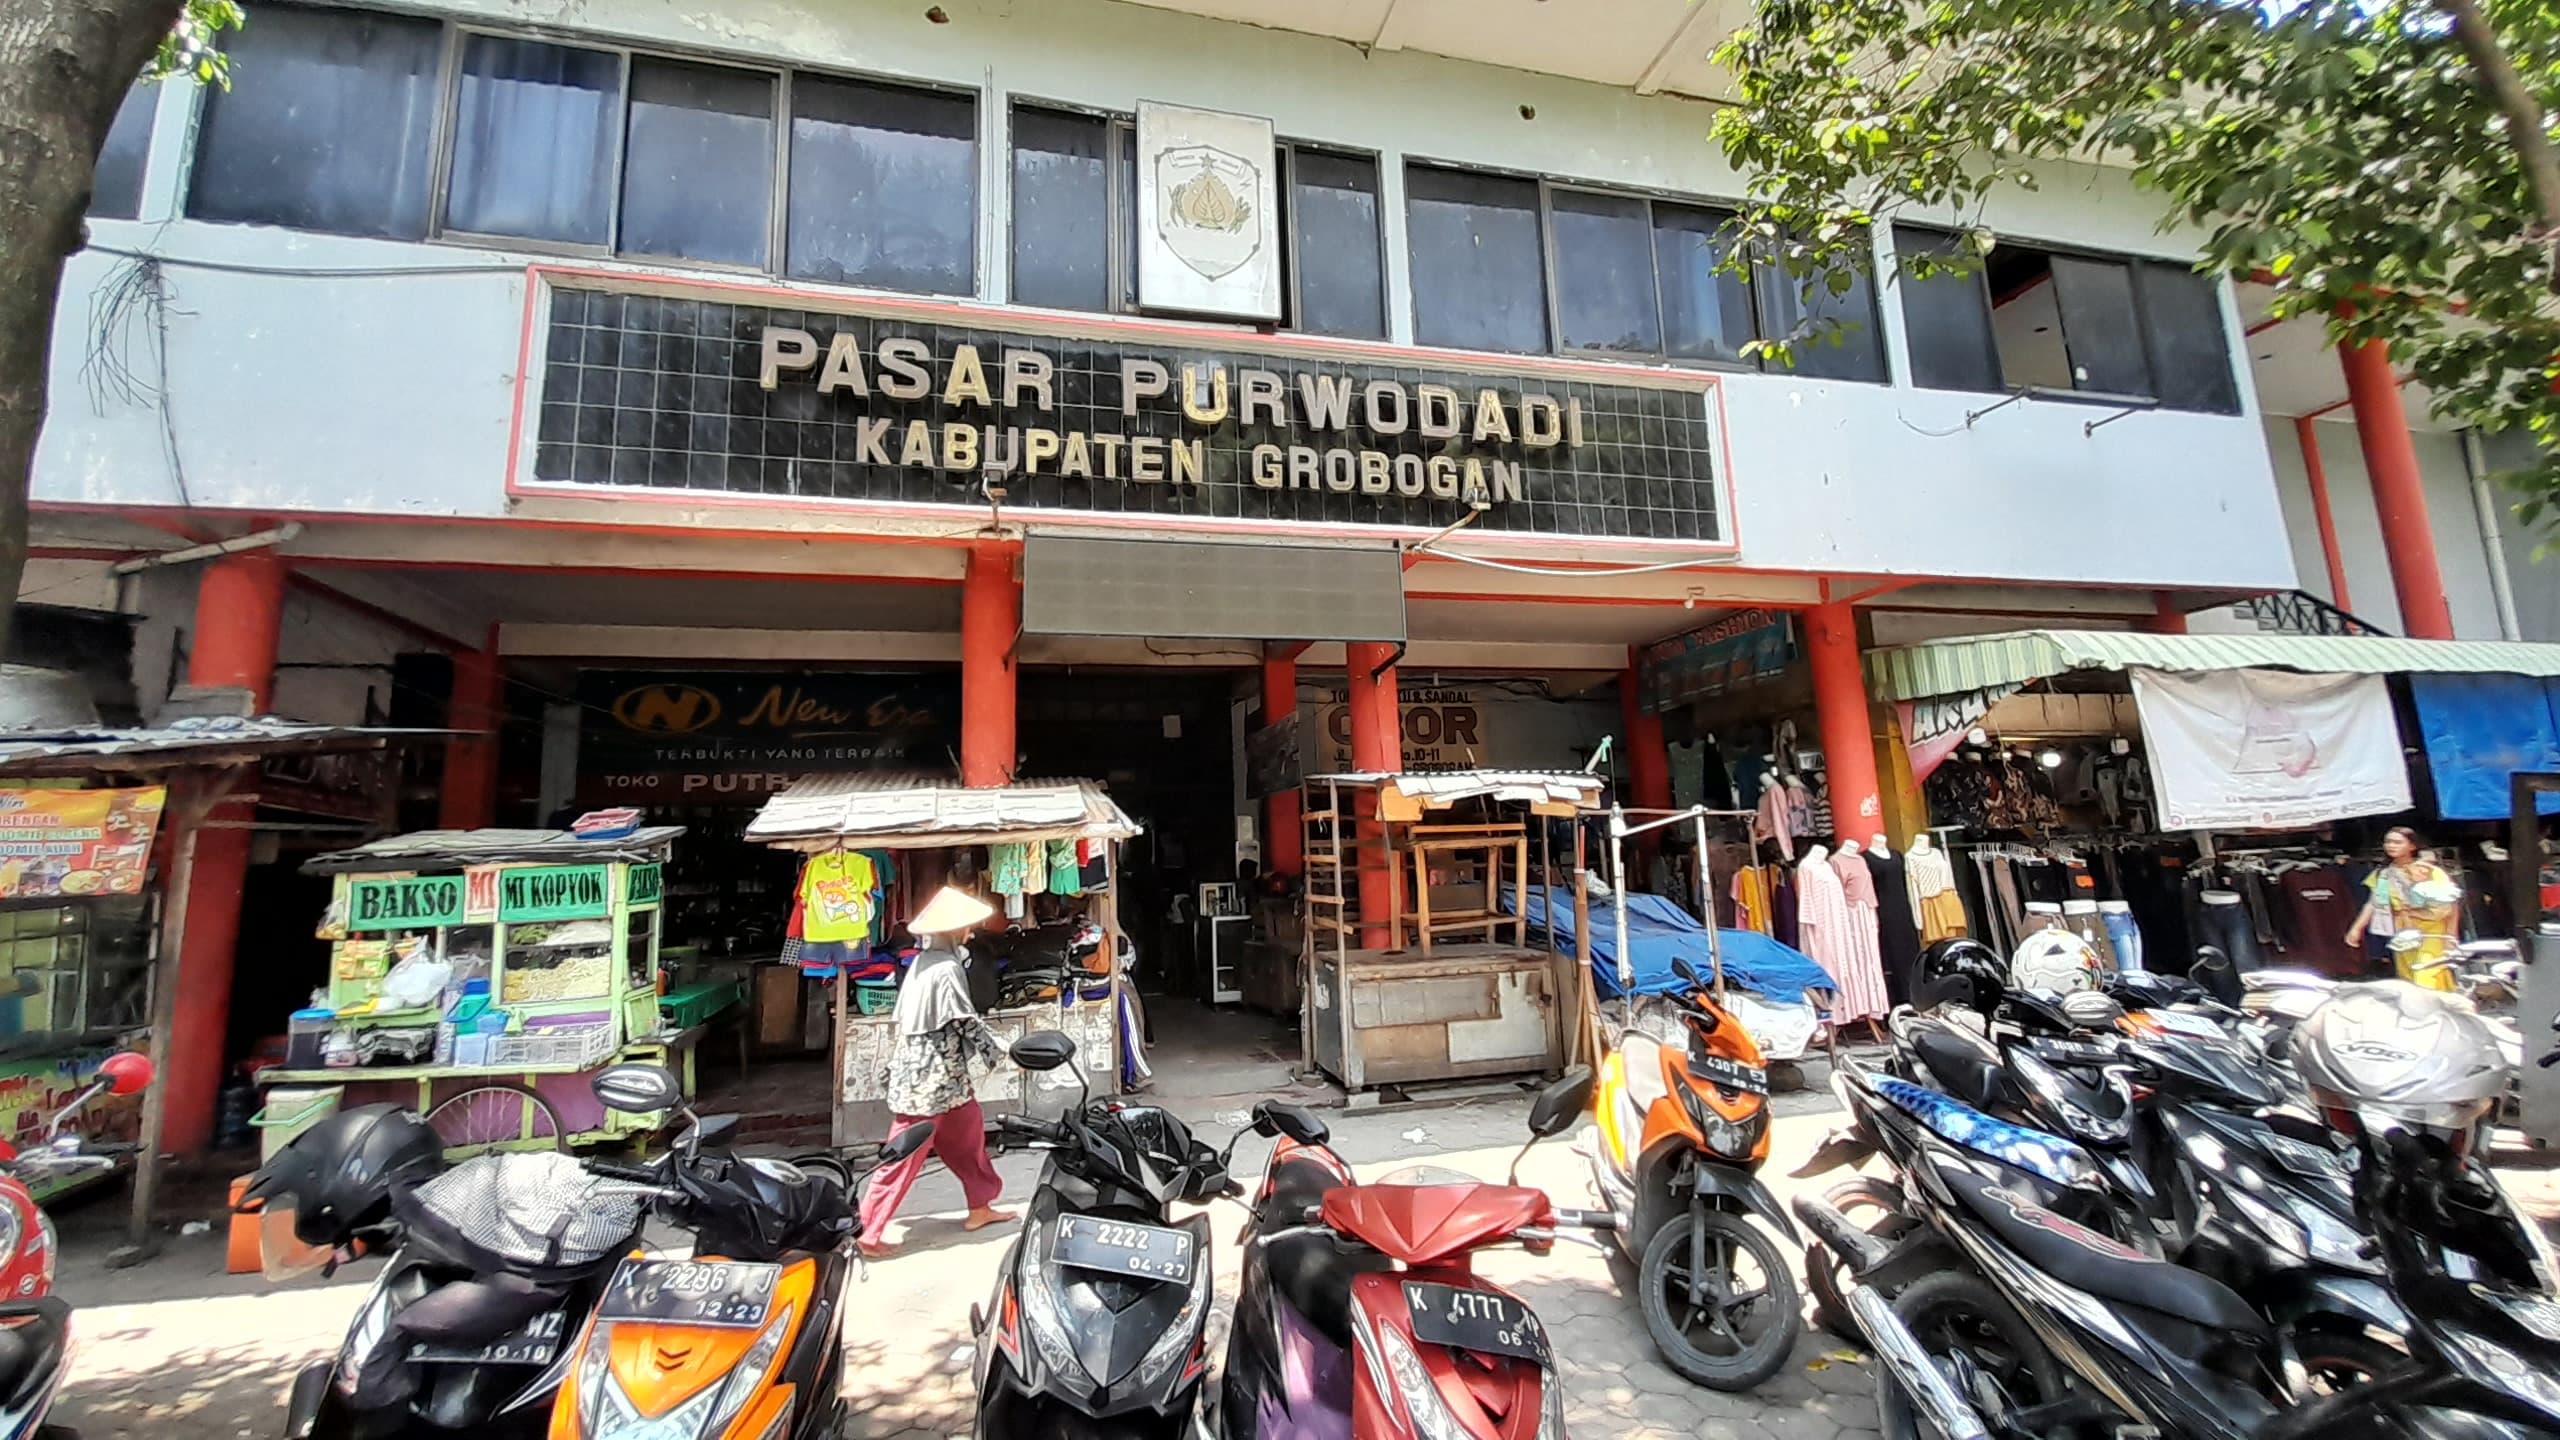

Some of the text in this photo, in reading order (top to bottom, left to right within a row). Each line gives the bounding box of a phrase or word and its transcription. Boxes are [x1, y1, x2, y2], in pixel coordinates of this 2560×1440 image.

[759, 326, 1583, 449] PASAR PURWODADI
[855, 415, 1522, 502] KABUPATEN GROBOGAN
[738, 684, 850, 727] New
[868, 694, 934, 728] Era
[1425, 689, 1473, 704] SANDAL
[1328, 706, 1479, 746] OOR
[655, 746, 757, 761] TERBUKTI
[765, 748, 817, 761] YANG
[605, 773, 792, 794] TOKO PUTR
[504, 871, 602, 909] MI KOPYOK
[629, 865, 659, 898] BAKSO
[358, 881, 458, 921] BAKSO
[1687, 1050, 1697, 1062] K
[1060, 1219, 1189, 1257] K 2222 P
[616, 1264, 774, 1293] K 2296 J
[1409, 1286, 1429, 1312] K
